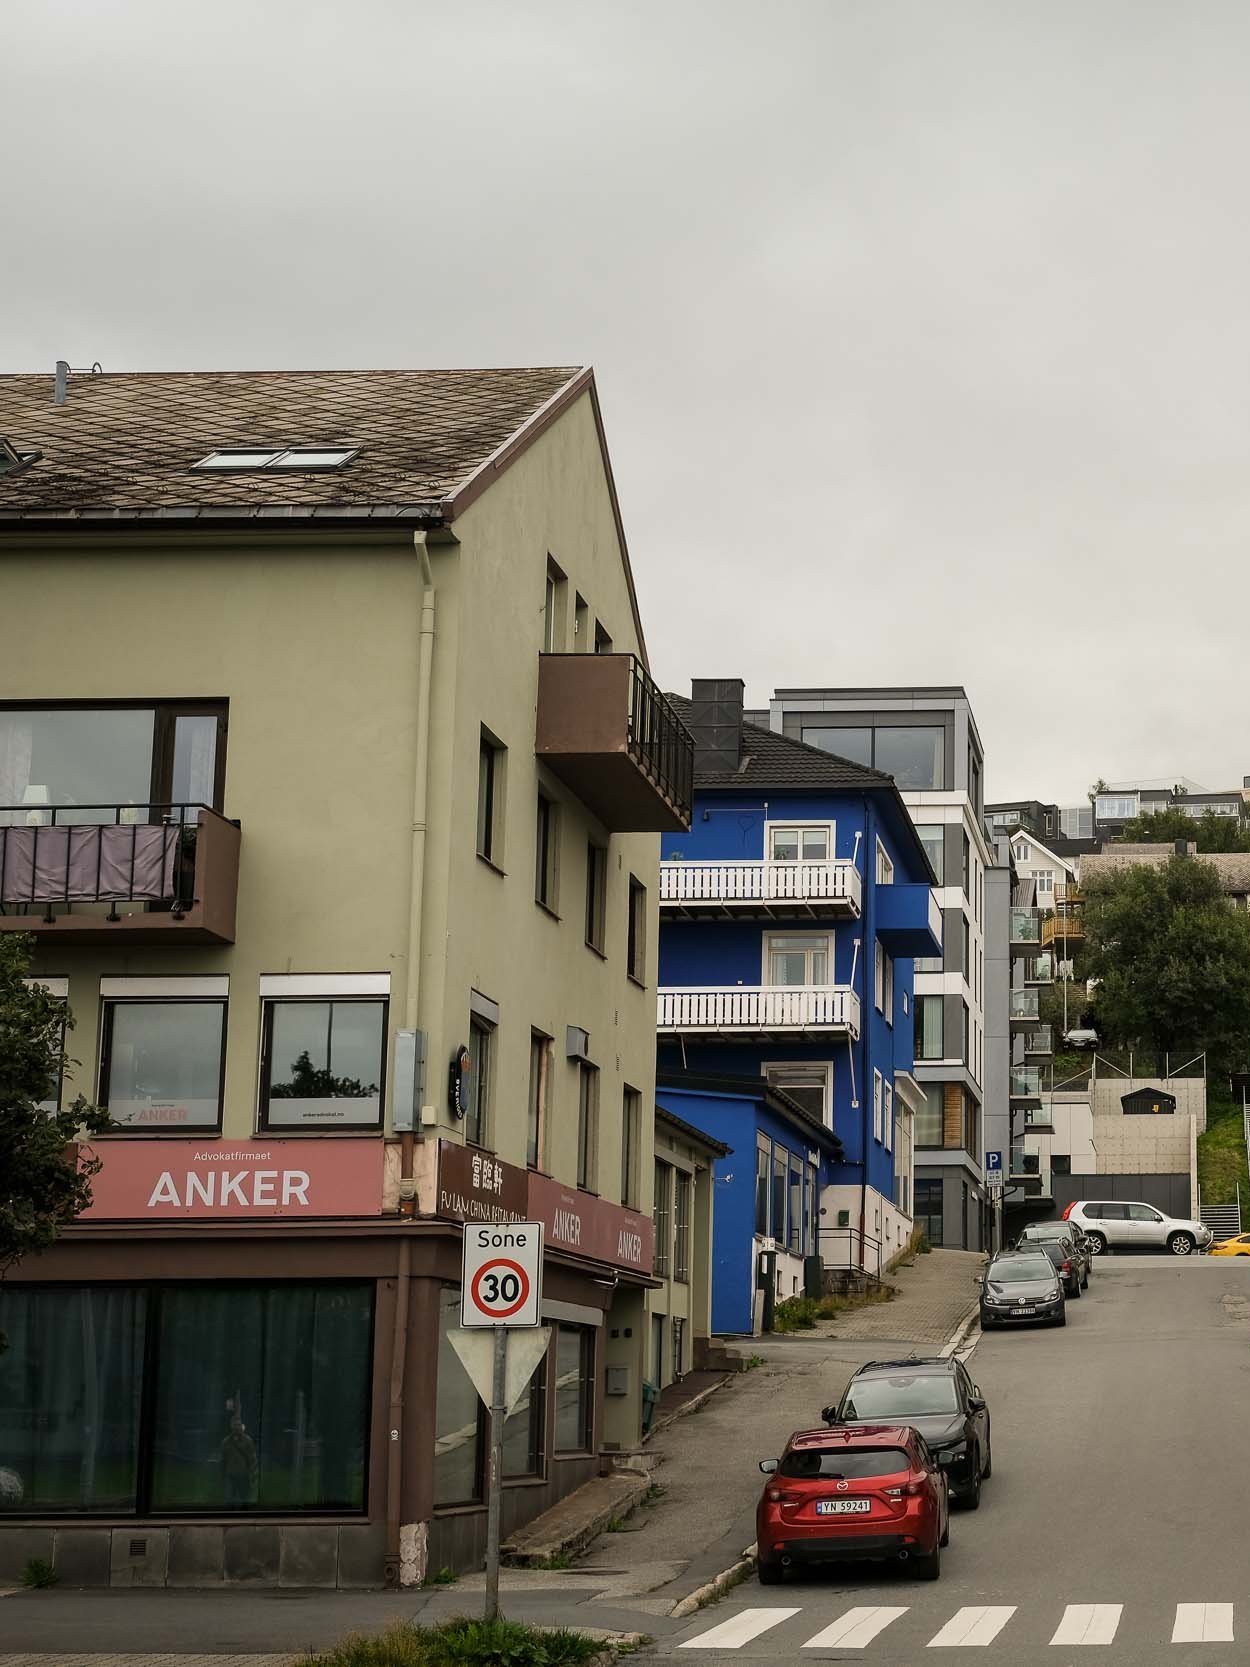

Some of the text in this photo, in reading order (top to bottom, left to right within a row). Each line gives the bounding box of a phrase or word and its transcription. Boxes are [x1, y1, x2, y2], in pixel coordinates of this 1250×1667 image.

[138, 1109, 188, 1121] ANKER
[193, 1151, 272, 1161] Advokatfirmaet
[989, 1153, 999, 1169] P
[147, 1170, 310, 1207] ANKER
[452, 1192, 469, 1215] LAM
[470, 1199, 491, 1222] CHINA
[552, 1207, 581, 1246] ANKER
[478, 1230, 527, 1248] Sone
[617, 1230, 642, 1264] ANKER
[482, 1273, 520, 1303] 30
[824, 1501, 869, 1512] YN 59241
